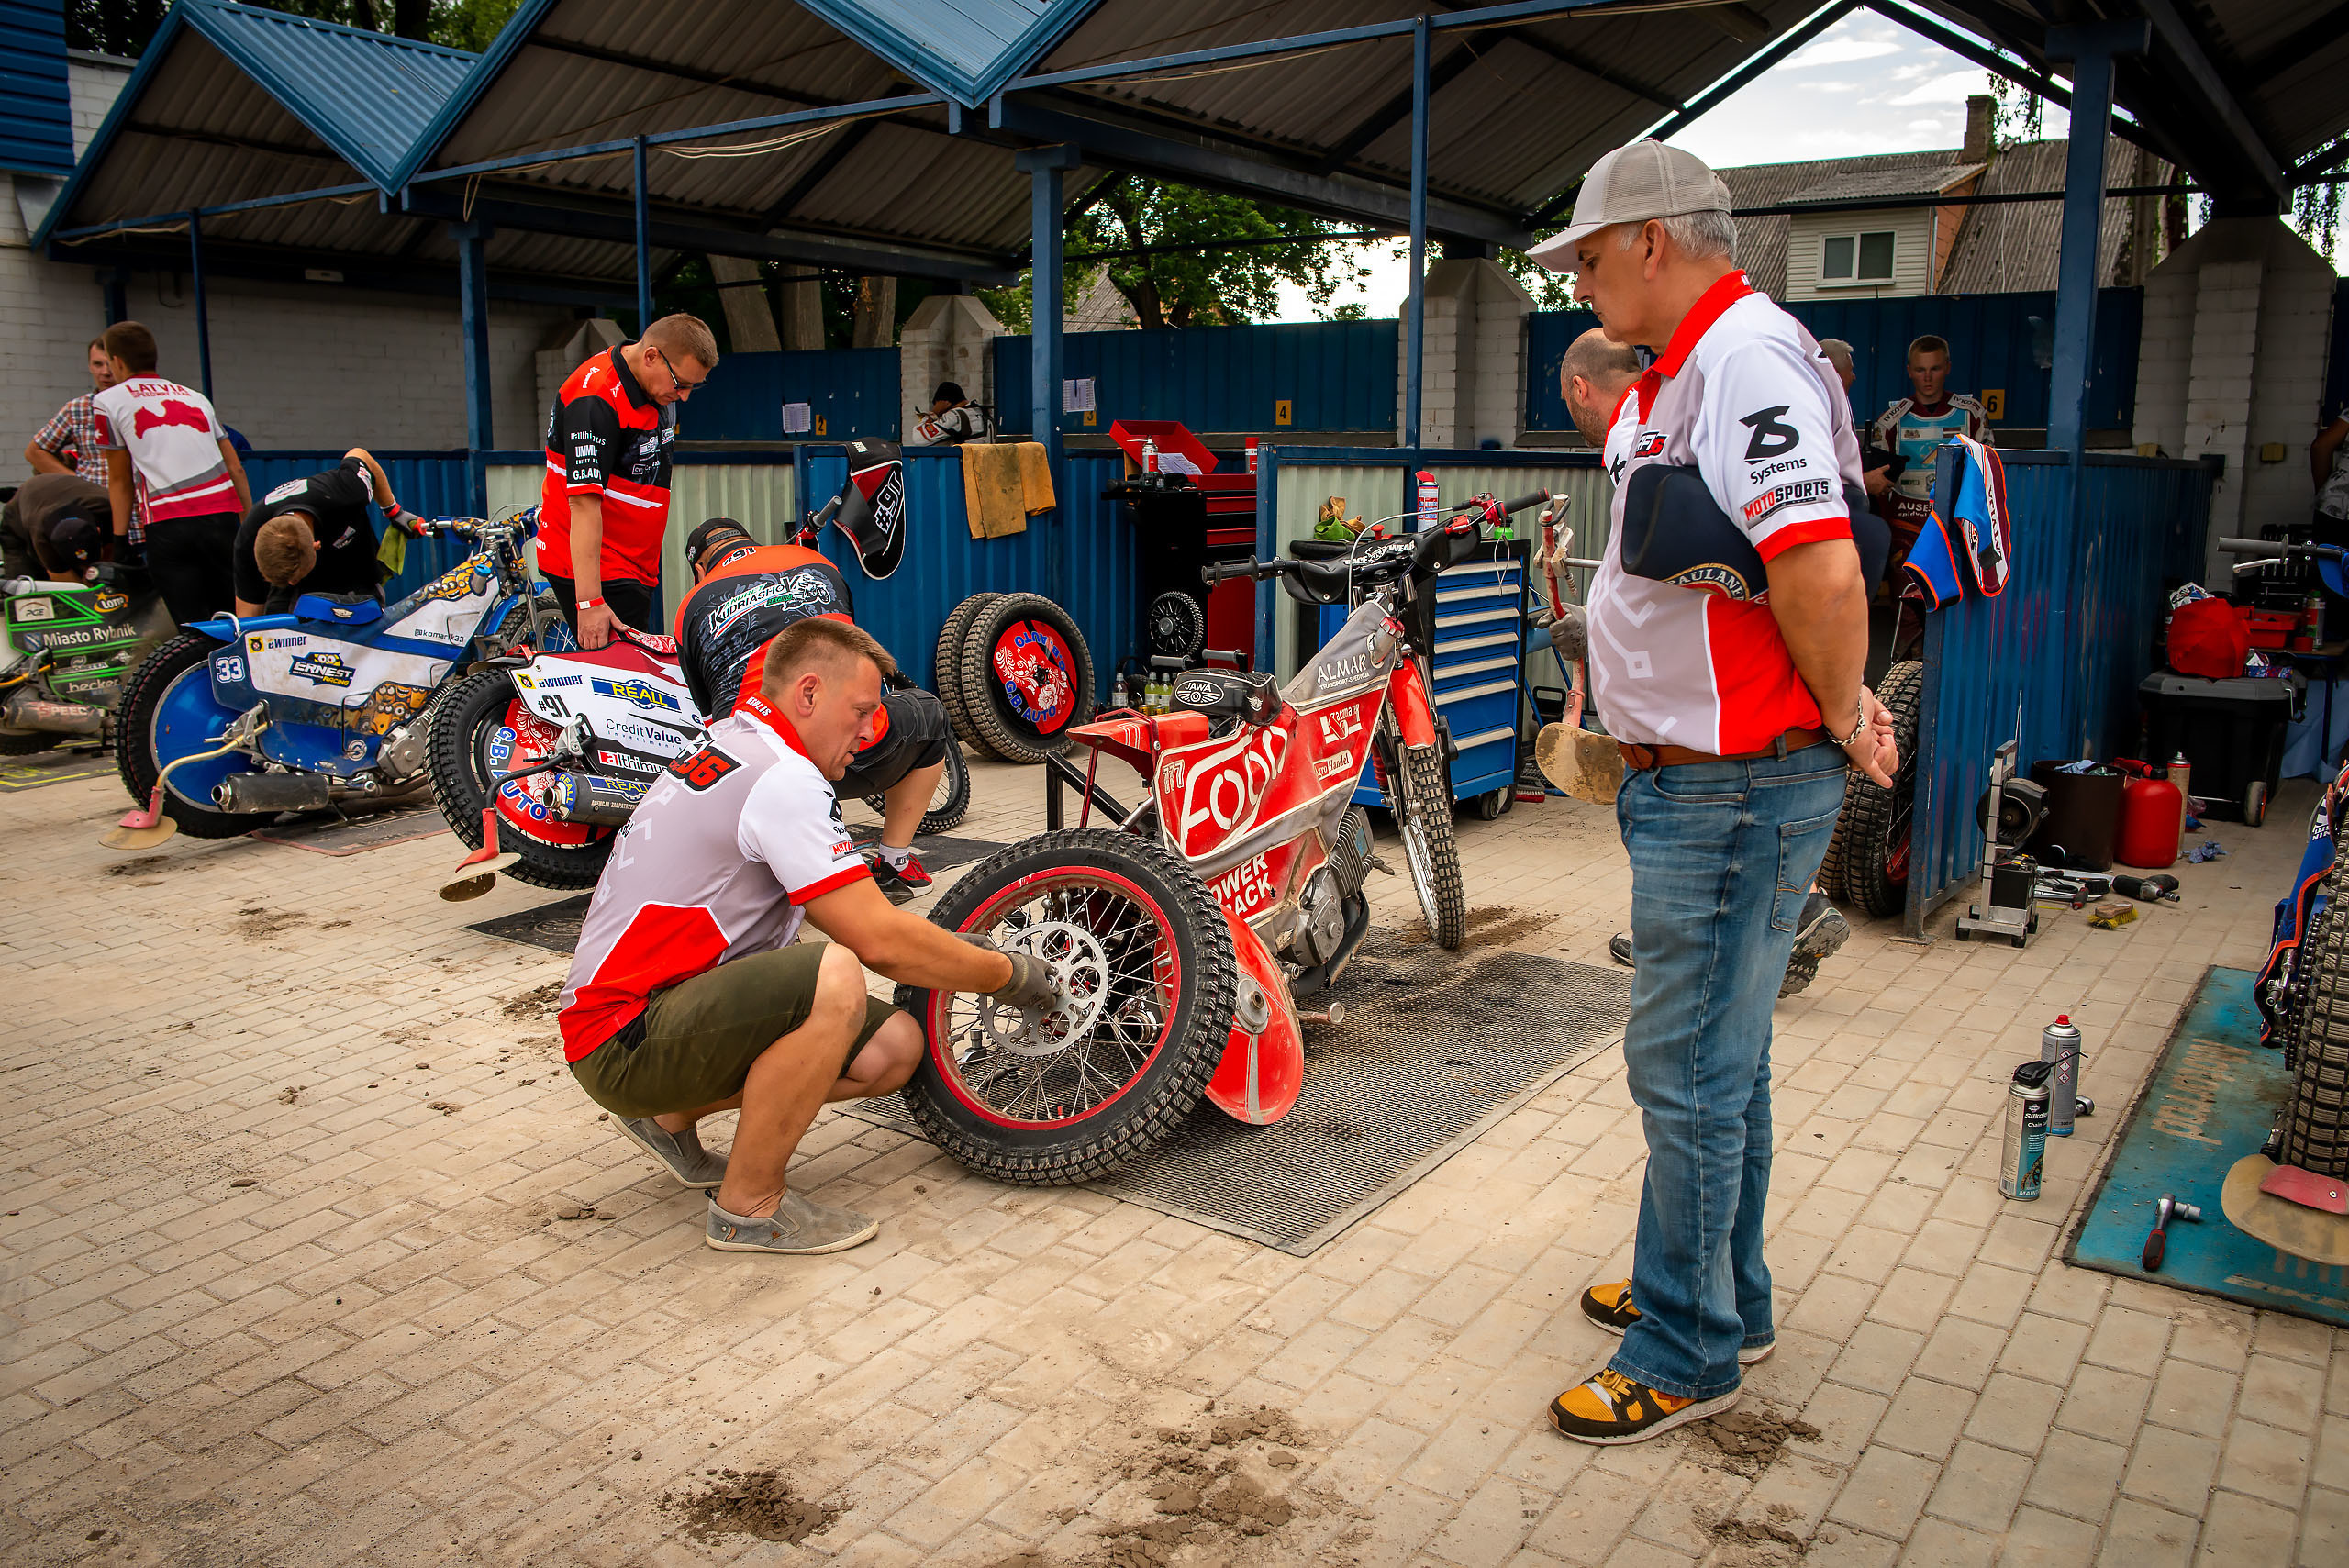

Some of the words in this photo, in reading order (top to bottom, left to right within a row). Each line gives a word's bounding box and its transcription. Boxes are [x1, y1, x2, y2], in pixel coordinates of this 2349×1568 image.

[125, 384, 188, 393] LATVIA
[1279, 405, 1286, 419] 4
[1987, 395, 1998, 413] 6
[818, 415, 825, 431] 2
[1750, 458, 1807, 484] Systems
[1744, 480, 1829, 521] MOTOSPORTS
[1898, 502, 1931, 512] AUSE
[1388, 540, 1415, 552] WEAR
[43, 629, 91, 647] Miasto
[93, 624, 136, 642] Rybnik
[216, 656, 245, 683] 33
[294, 661, 353, 677] ERNEST
[1317, 653, 1367, 684] ALMAR
[68, 679, 118, 693] becker
[323, 675, 349, 686] RACING
[1185, 682, 1212, 693] JAWA
[612, 684, 668, 706] REALL
[538, 695, 572, 718] #91
[1021, 705, 1057, 723] AUTO
[676, 750, 732, 786] 56
[1329, 753, 1349, 772] Handel
[559, 774, 573, 804] REALL
[832, 841, 853, 854] MOTO
[1211, 853, 1268, 904] OWER
[1226, 872, 1271, 916] ACK
